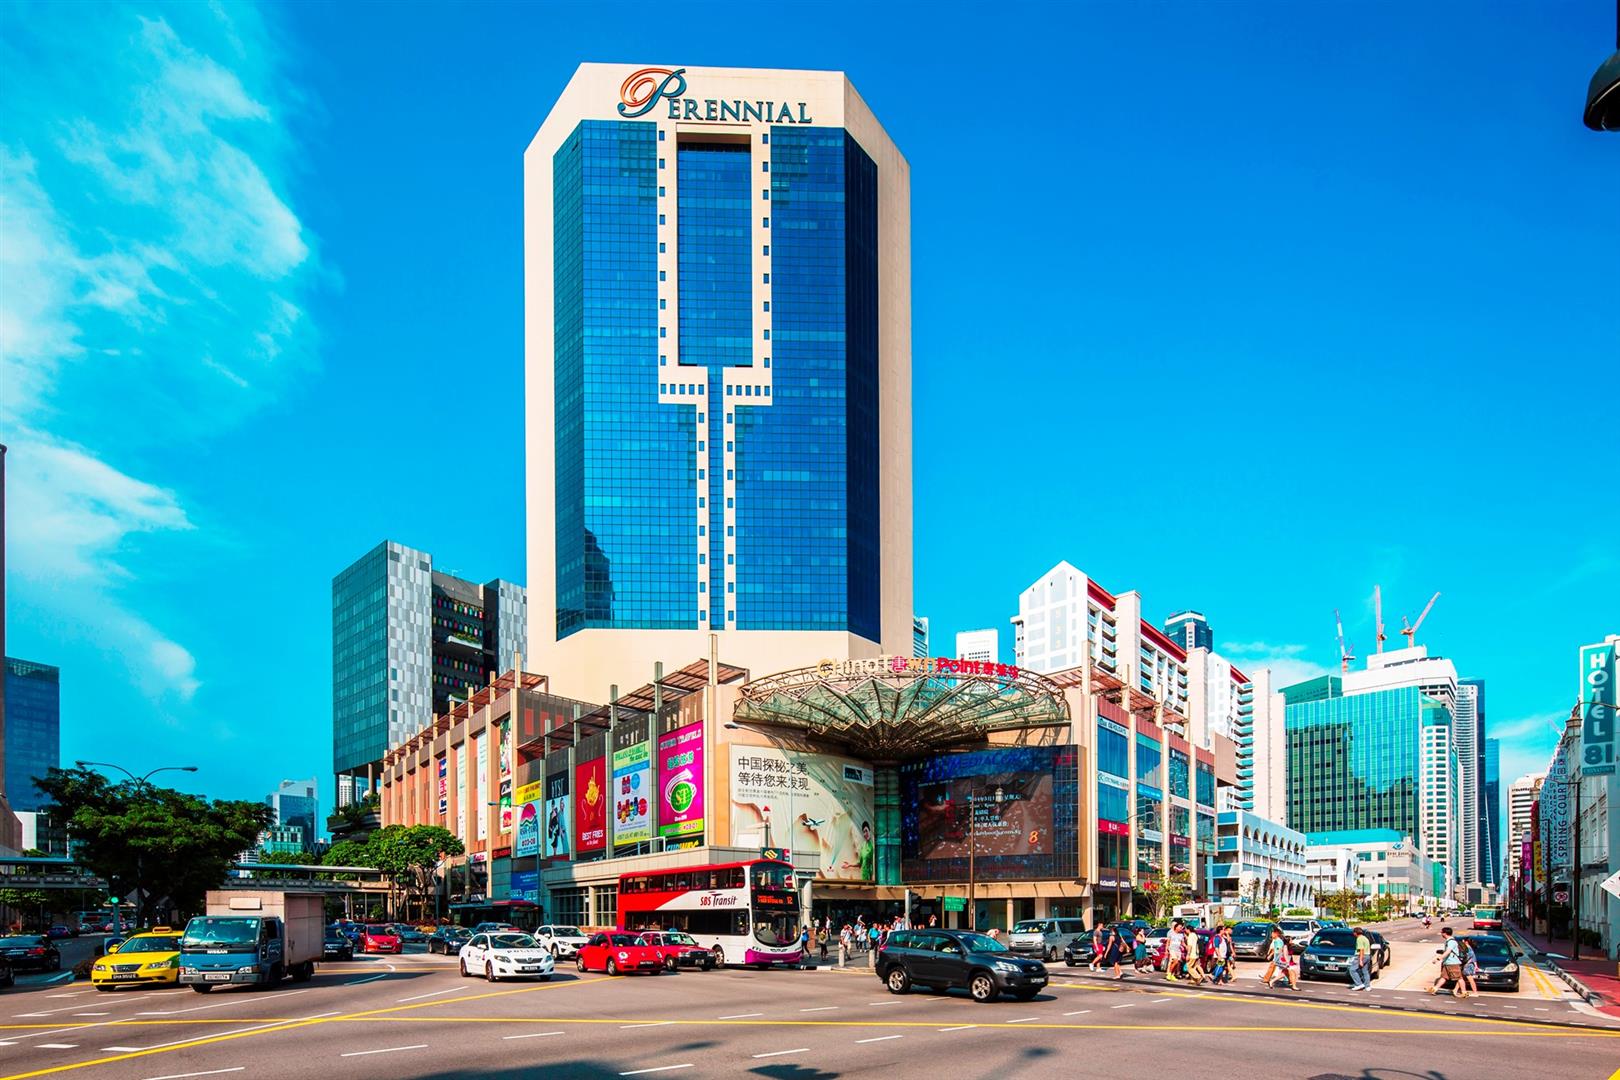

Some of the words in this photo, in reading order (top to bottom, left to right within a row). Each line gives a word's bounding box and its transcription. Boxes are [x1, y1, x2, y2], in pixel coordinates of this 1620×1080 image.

[617, 68, 813, 124] PERENNIAL
[937, 657, 981, 674] Point
[1588, 653, 1609, 737] HOTEL
[1584, 744, 1613, 765] 81
[1028, 831, 1039, 843] 8
[1558, 820, 1568, 857] SPRING
[700, 896, 711, 906] SBS
[711, 893, 737, 907] Transit
[787, 896, 793, 904] 12
